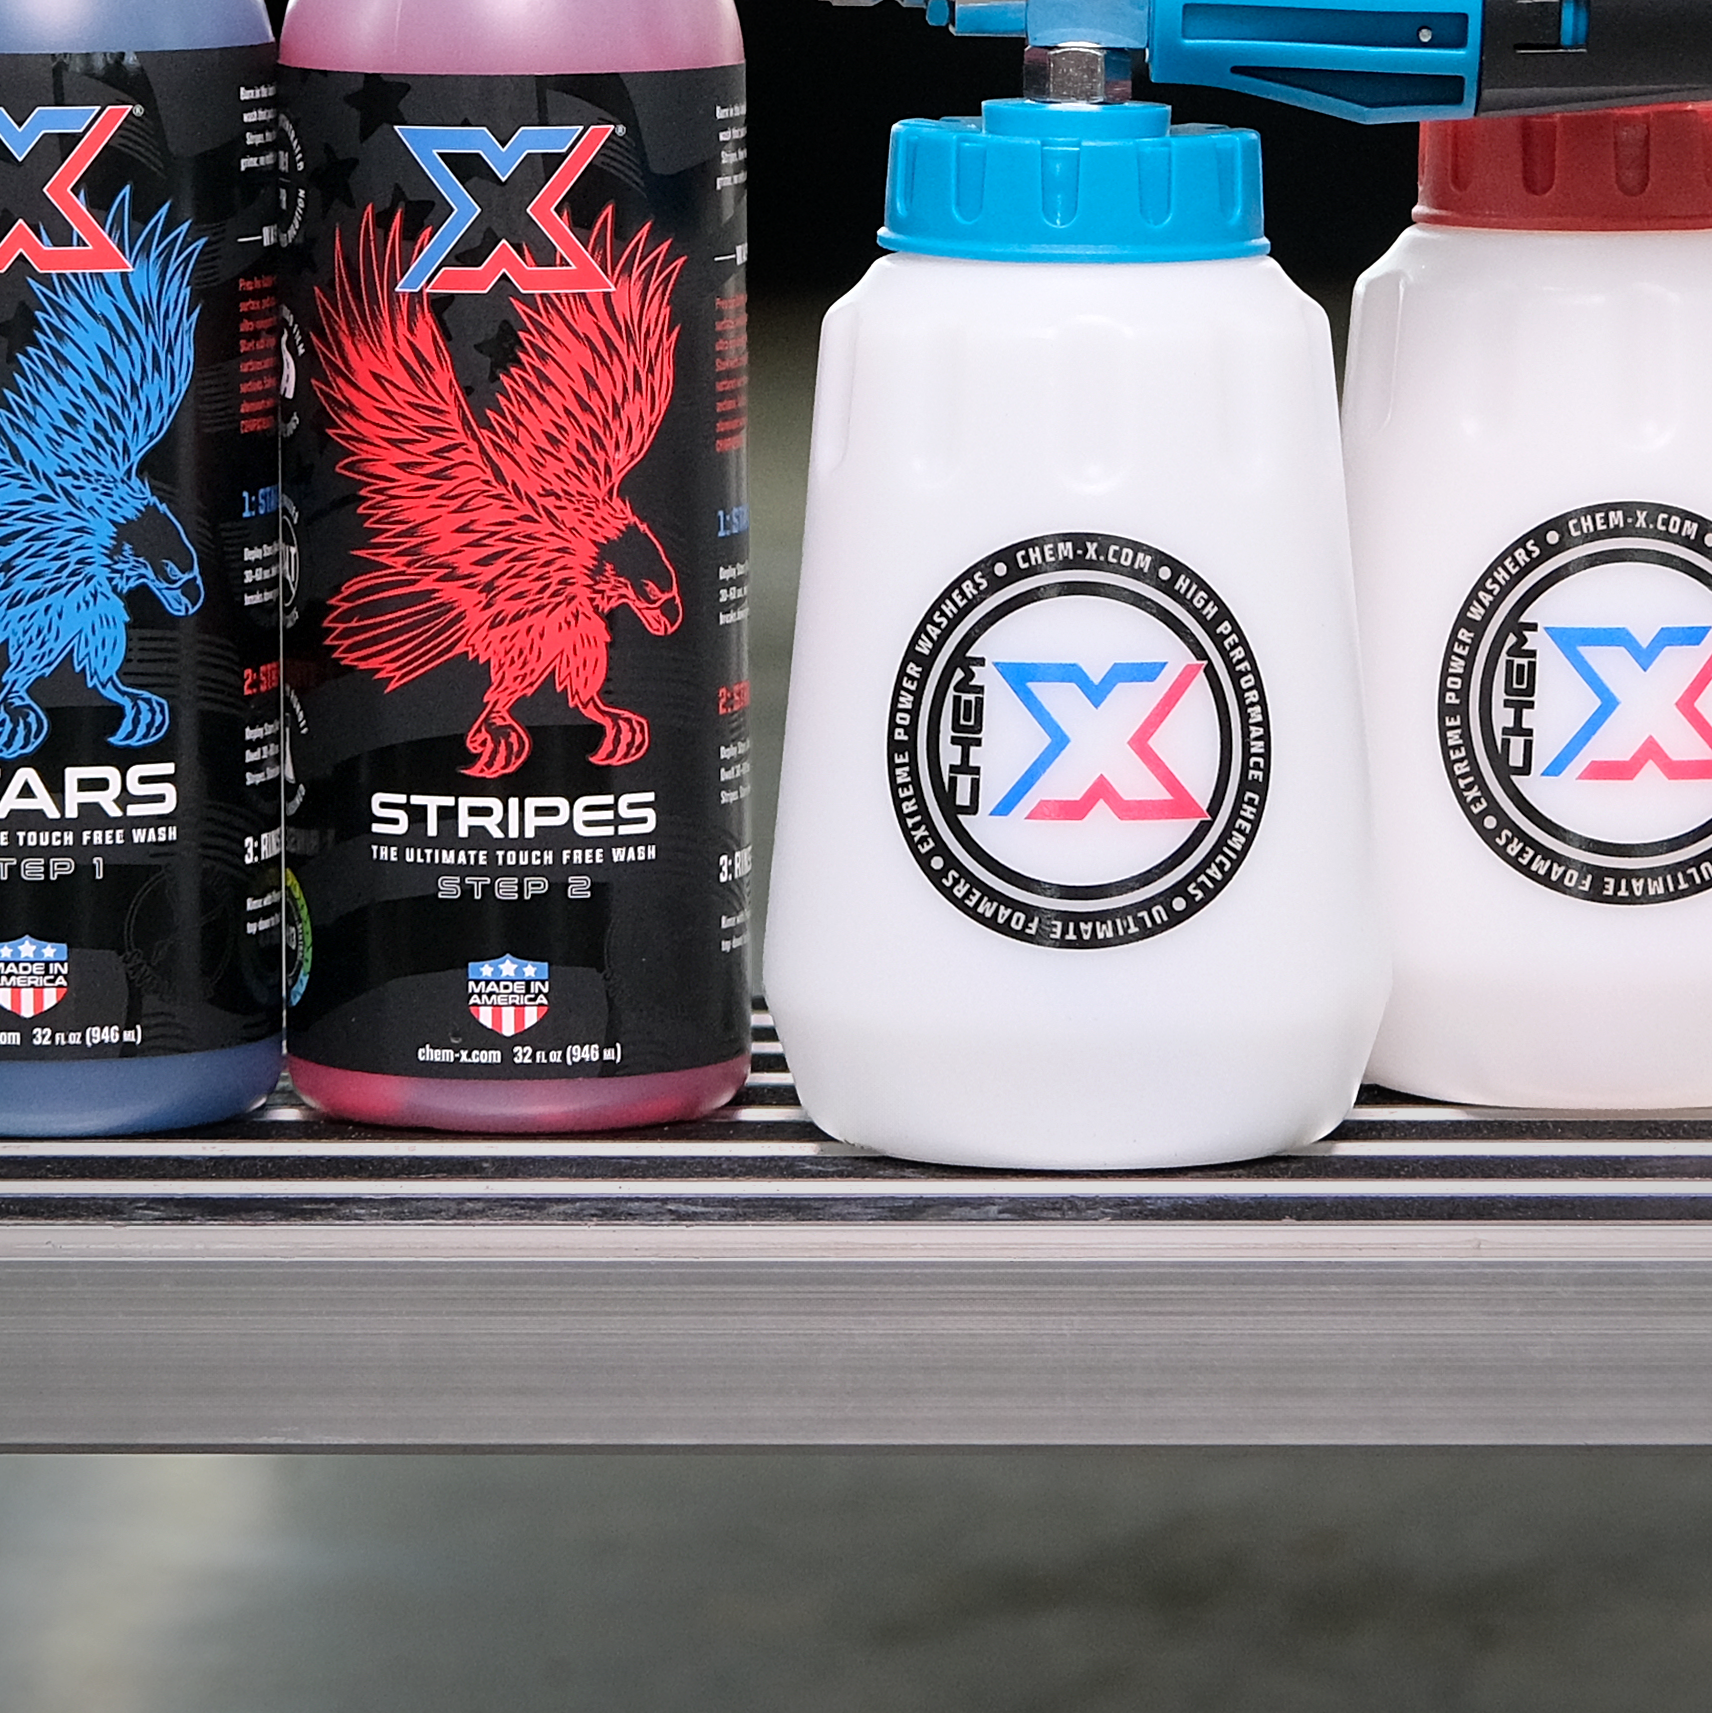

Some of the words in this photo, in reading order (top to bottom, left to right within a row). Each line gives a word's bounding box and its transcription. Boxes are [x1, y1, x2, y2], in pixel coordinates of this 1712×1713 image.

[1568, 509, 1699, 541] CHEM-X.COM
[1015, 540, 1153, 574] CHEM-X.COM
[1174, 573, 1218, 622] HIGH
[1466, 538, 1541, 623] WASHERS
[914, 569, 988, 657] WASHERS
[1445, 627, 1475, 705] POWER
[894, 663, 924, 742] POWER
[1215, 621, 1265, 783] PERFORMANCE
[1500, 621, 1539, 777] CHEM
[947, 656, 987, 816] CHEM
[1445, 714, 1488, 816] EXTREME
[370, 791, 657, 839] STRIPES
[893, 750, 935, 855] EXTREME
[16, 830, 74, 846] TOUCH
[82, 829, 125, 845] FREE
[131, 826, 177, 844] WASH
[244, 836, 259, 865] 3:
[371, 844, 398, 862] THE
[405, 846, 488, 865] ULTIMATE
[496, 849, 553, 865] TOUCH
[562, 848, 604, 865] FREE
[611, 844, 656, 862] WASH
[1186, 791, 1261, 903] CHEMICALS
[92, 856, 104, 880] 1
[718, 854, 733, 883] 3:
[1495, 827, 1591, 893] FOAMERS
[437, 876, 549, 900] STEP
[567, 875, 592, 899] 2
[942, 868, 1040, 936] FOAMERS
[1050, 903, 1169, 940] ULTIMATE
[48, 962, 68, 975] IN
[468, 981, 525, 993] MADE
[530, 981, 549, 993] IN
[468, 994, 549, 1005] AMERICA
[32, 1027, 53, 1046] 32
[85, 1025, 120, 1047] (946
[417, 1044, 502, 1064] chem-x.com
[512, 1045, 533, 1064] 32
[565, 1043, 600, 1066] (946
